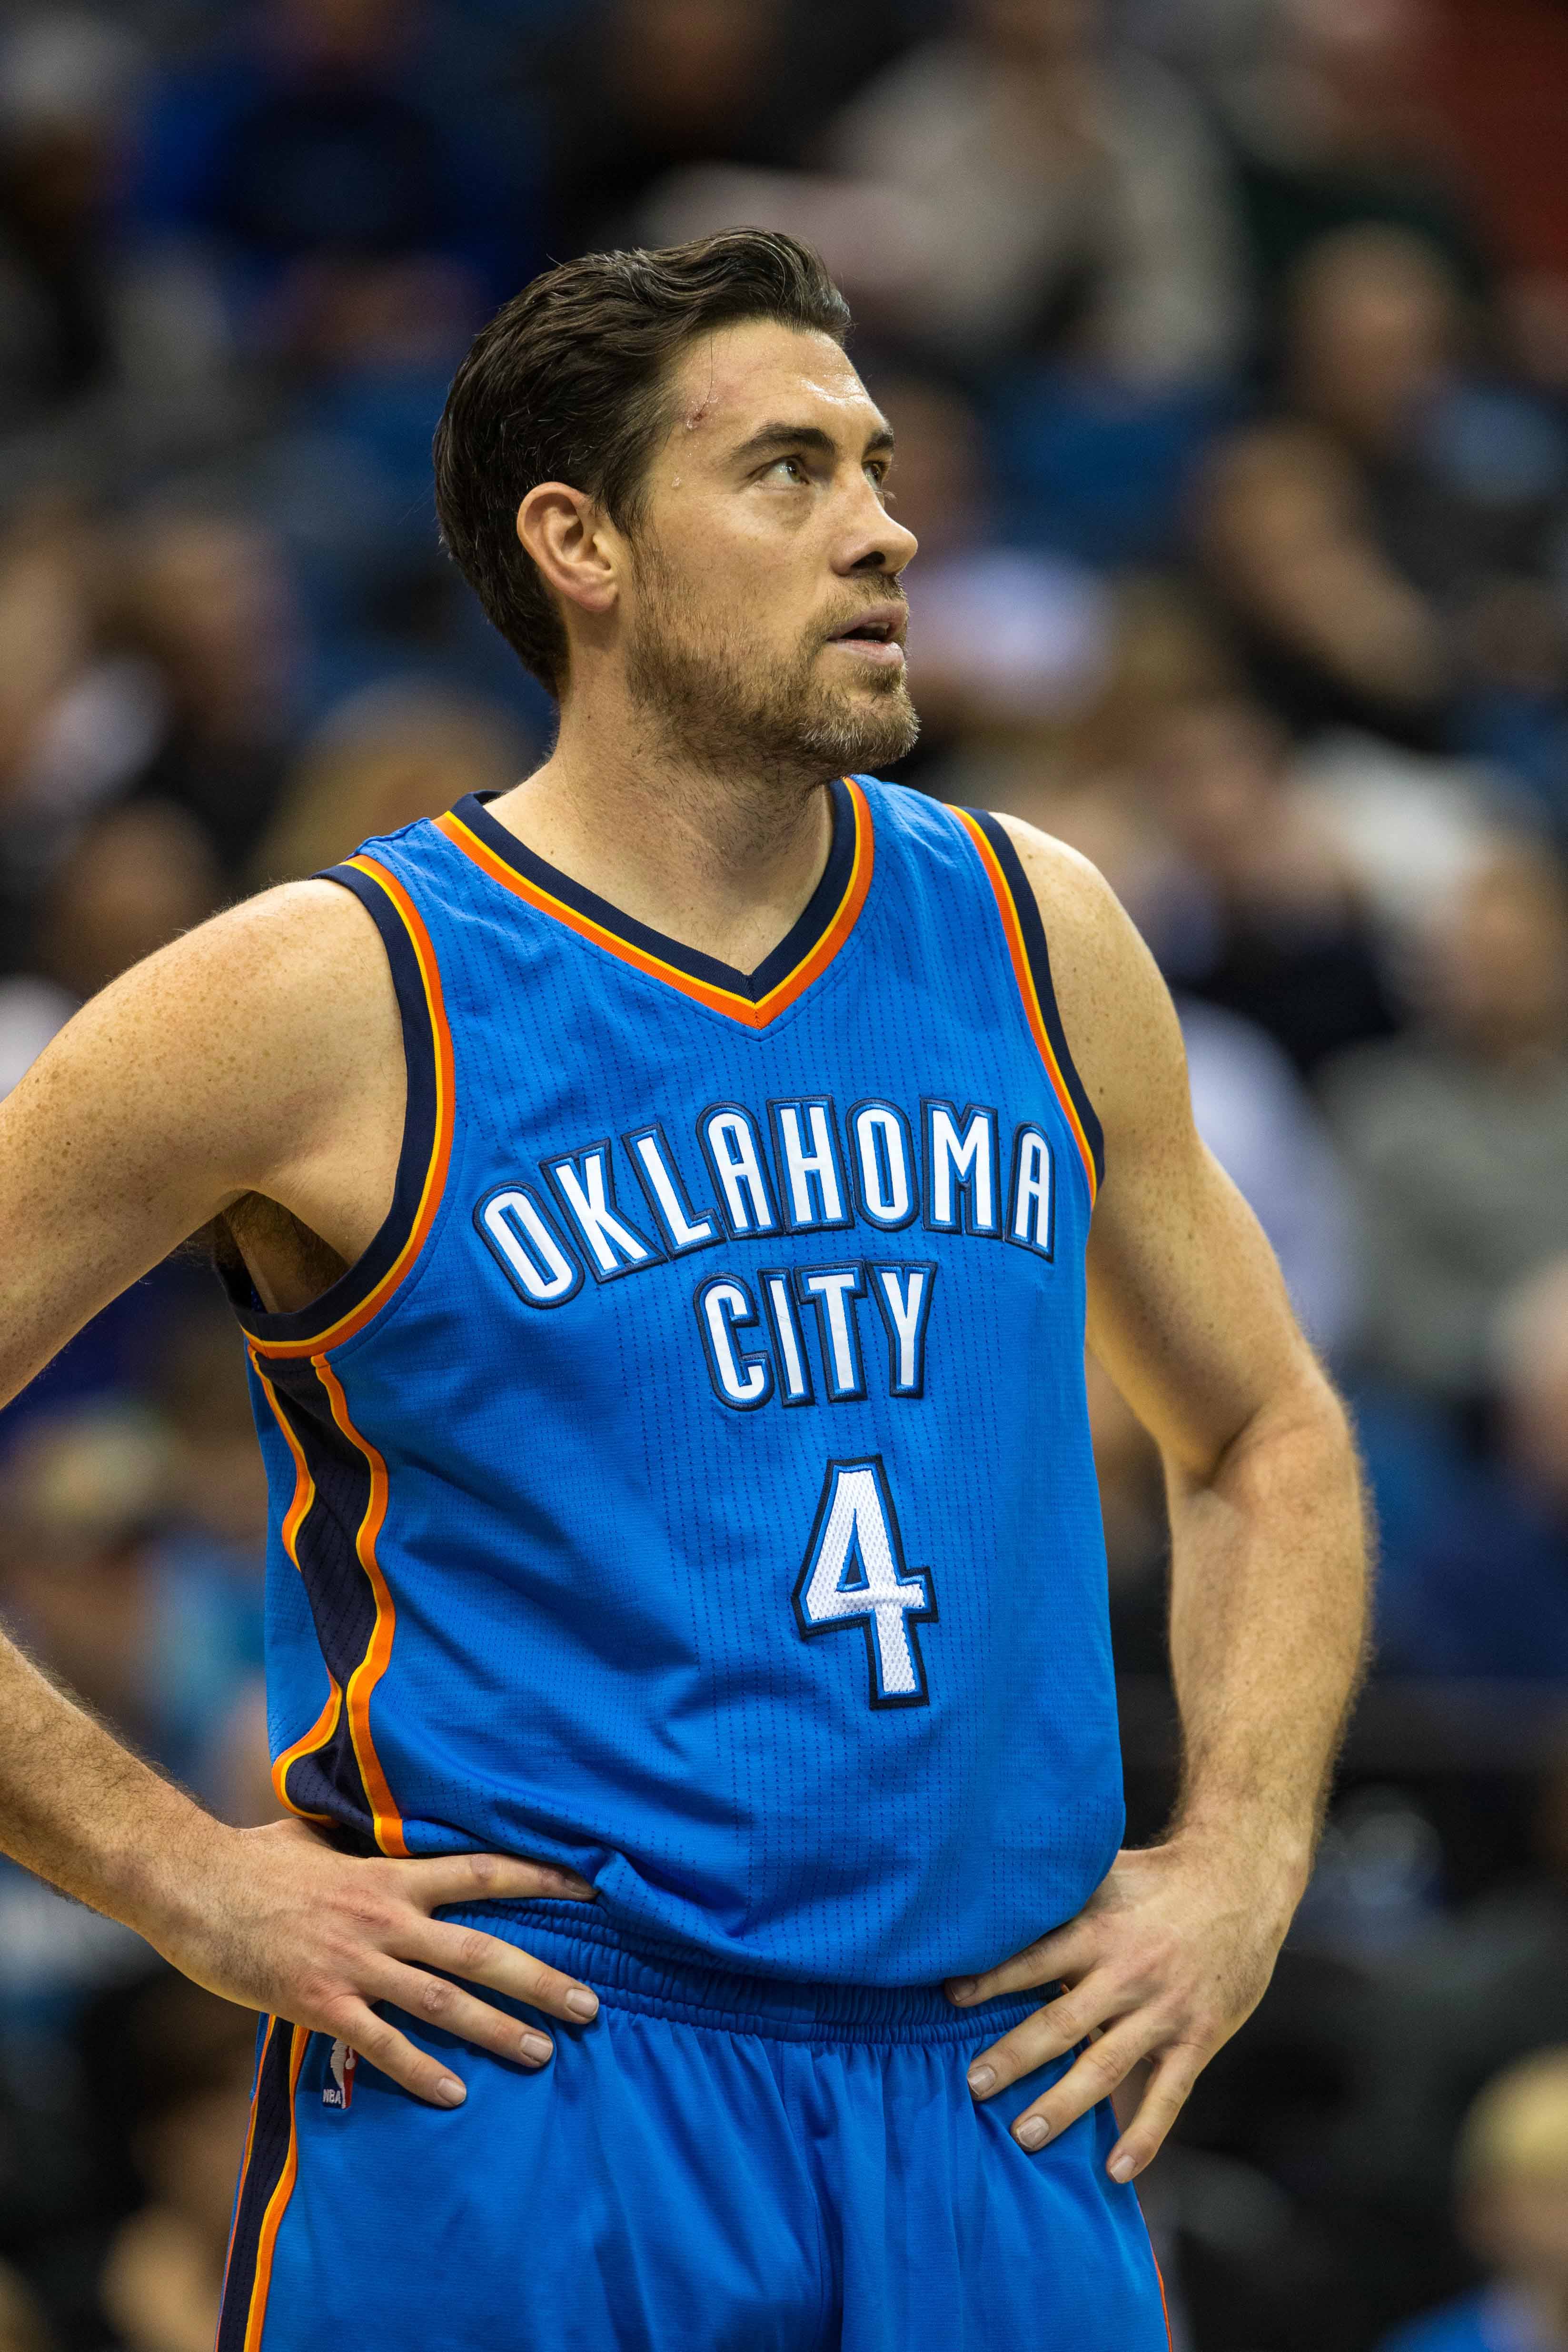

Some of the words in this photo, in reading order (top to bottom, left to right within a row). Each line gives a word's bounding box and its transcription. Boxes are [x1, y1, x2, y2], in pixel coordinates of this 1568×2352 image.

[475, 1095, 1054, 1309] OKLAHOMA
[693, 1259, 940, 1411] CITY
[791, 1455, 939, 1709] 4
[323, 2089, 342, 2104] NBA
